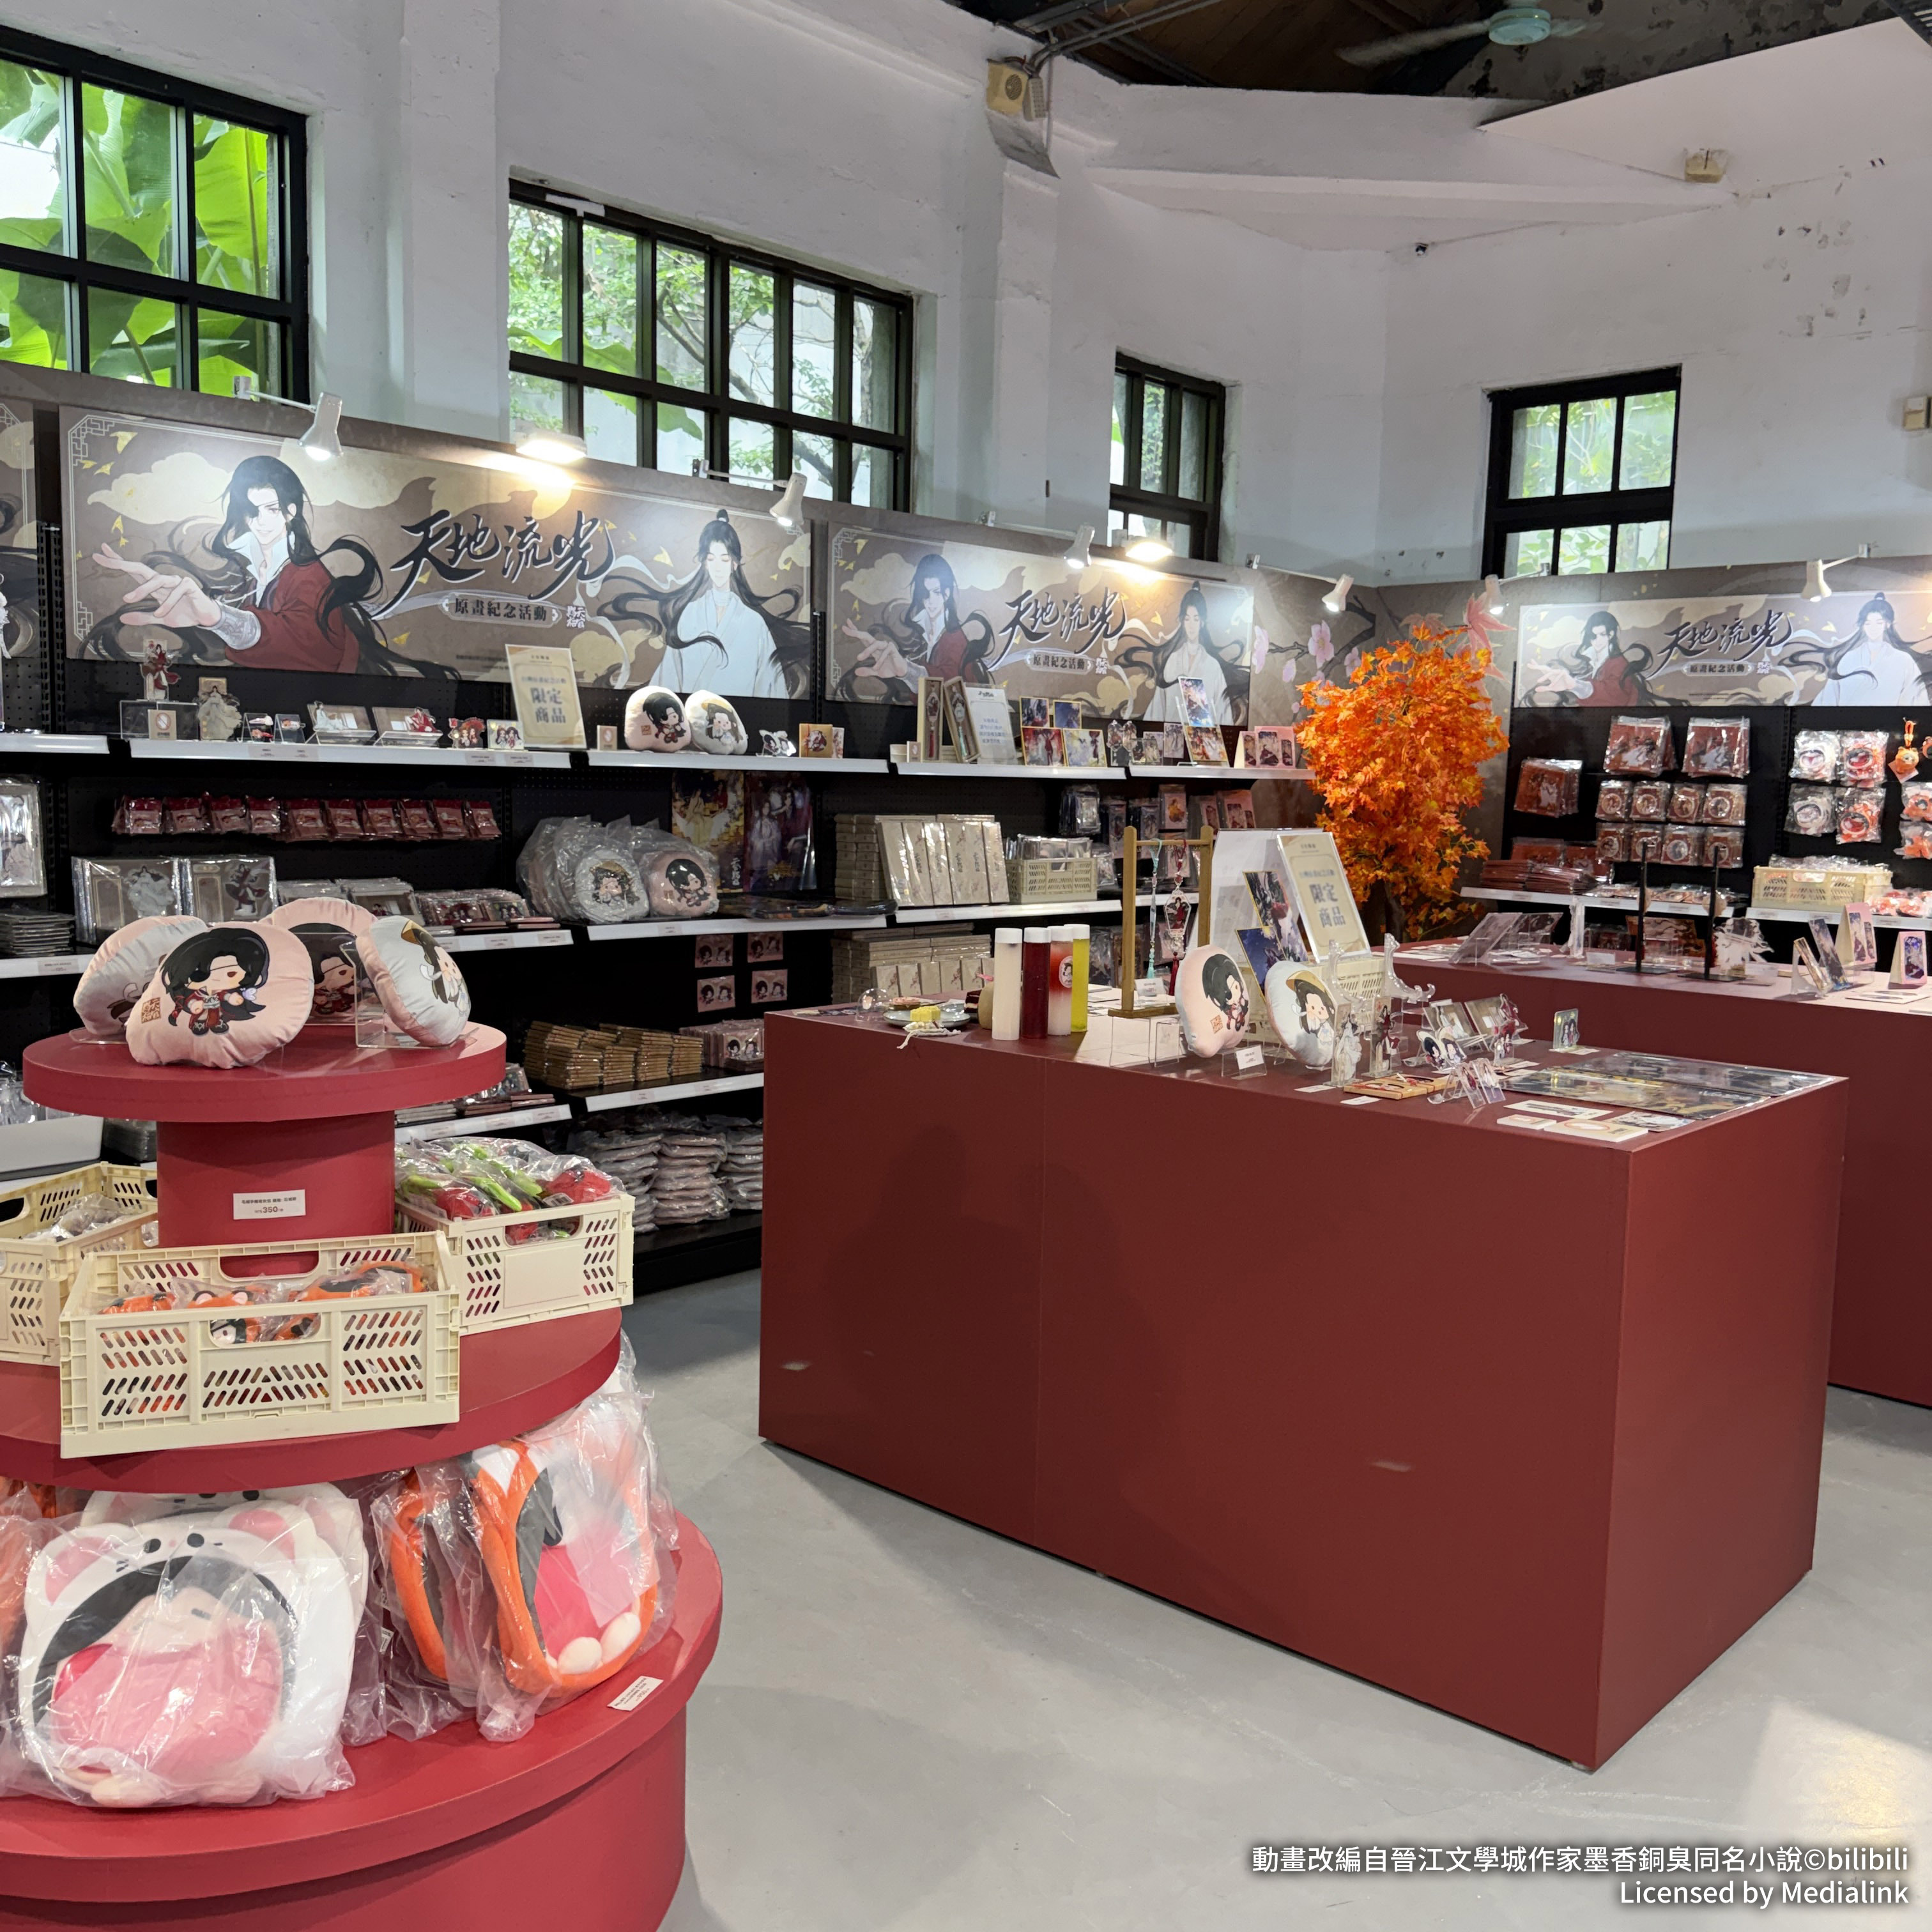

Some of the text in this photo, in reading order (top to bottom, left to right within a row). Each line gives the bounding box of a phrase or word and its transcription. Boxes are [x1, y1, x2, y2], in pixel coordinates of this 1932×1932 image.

[454, 598, 547, 622] 原畫紀念活動
[1032, 654, 1085, 670] 原畫紀念活動
[530, 687, 564, 704] 限定
[535, 707, 567, 724] 商品
[1309, 883, 1339, 904] 限定
[1319, 906, 1346, 928] 商品
